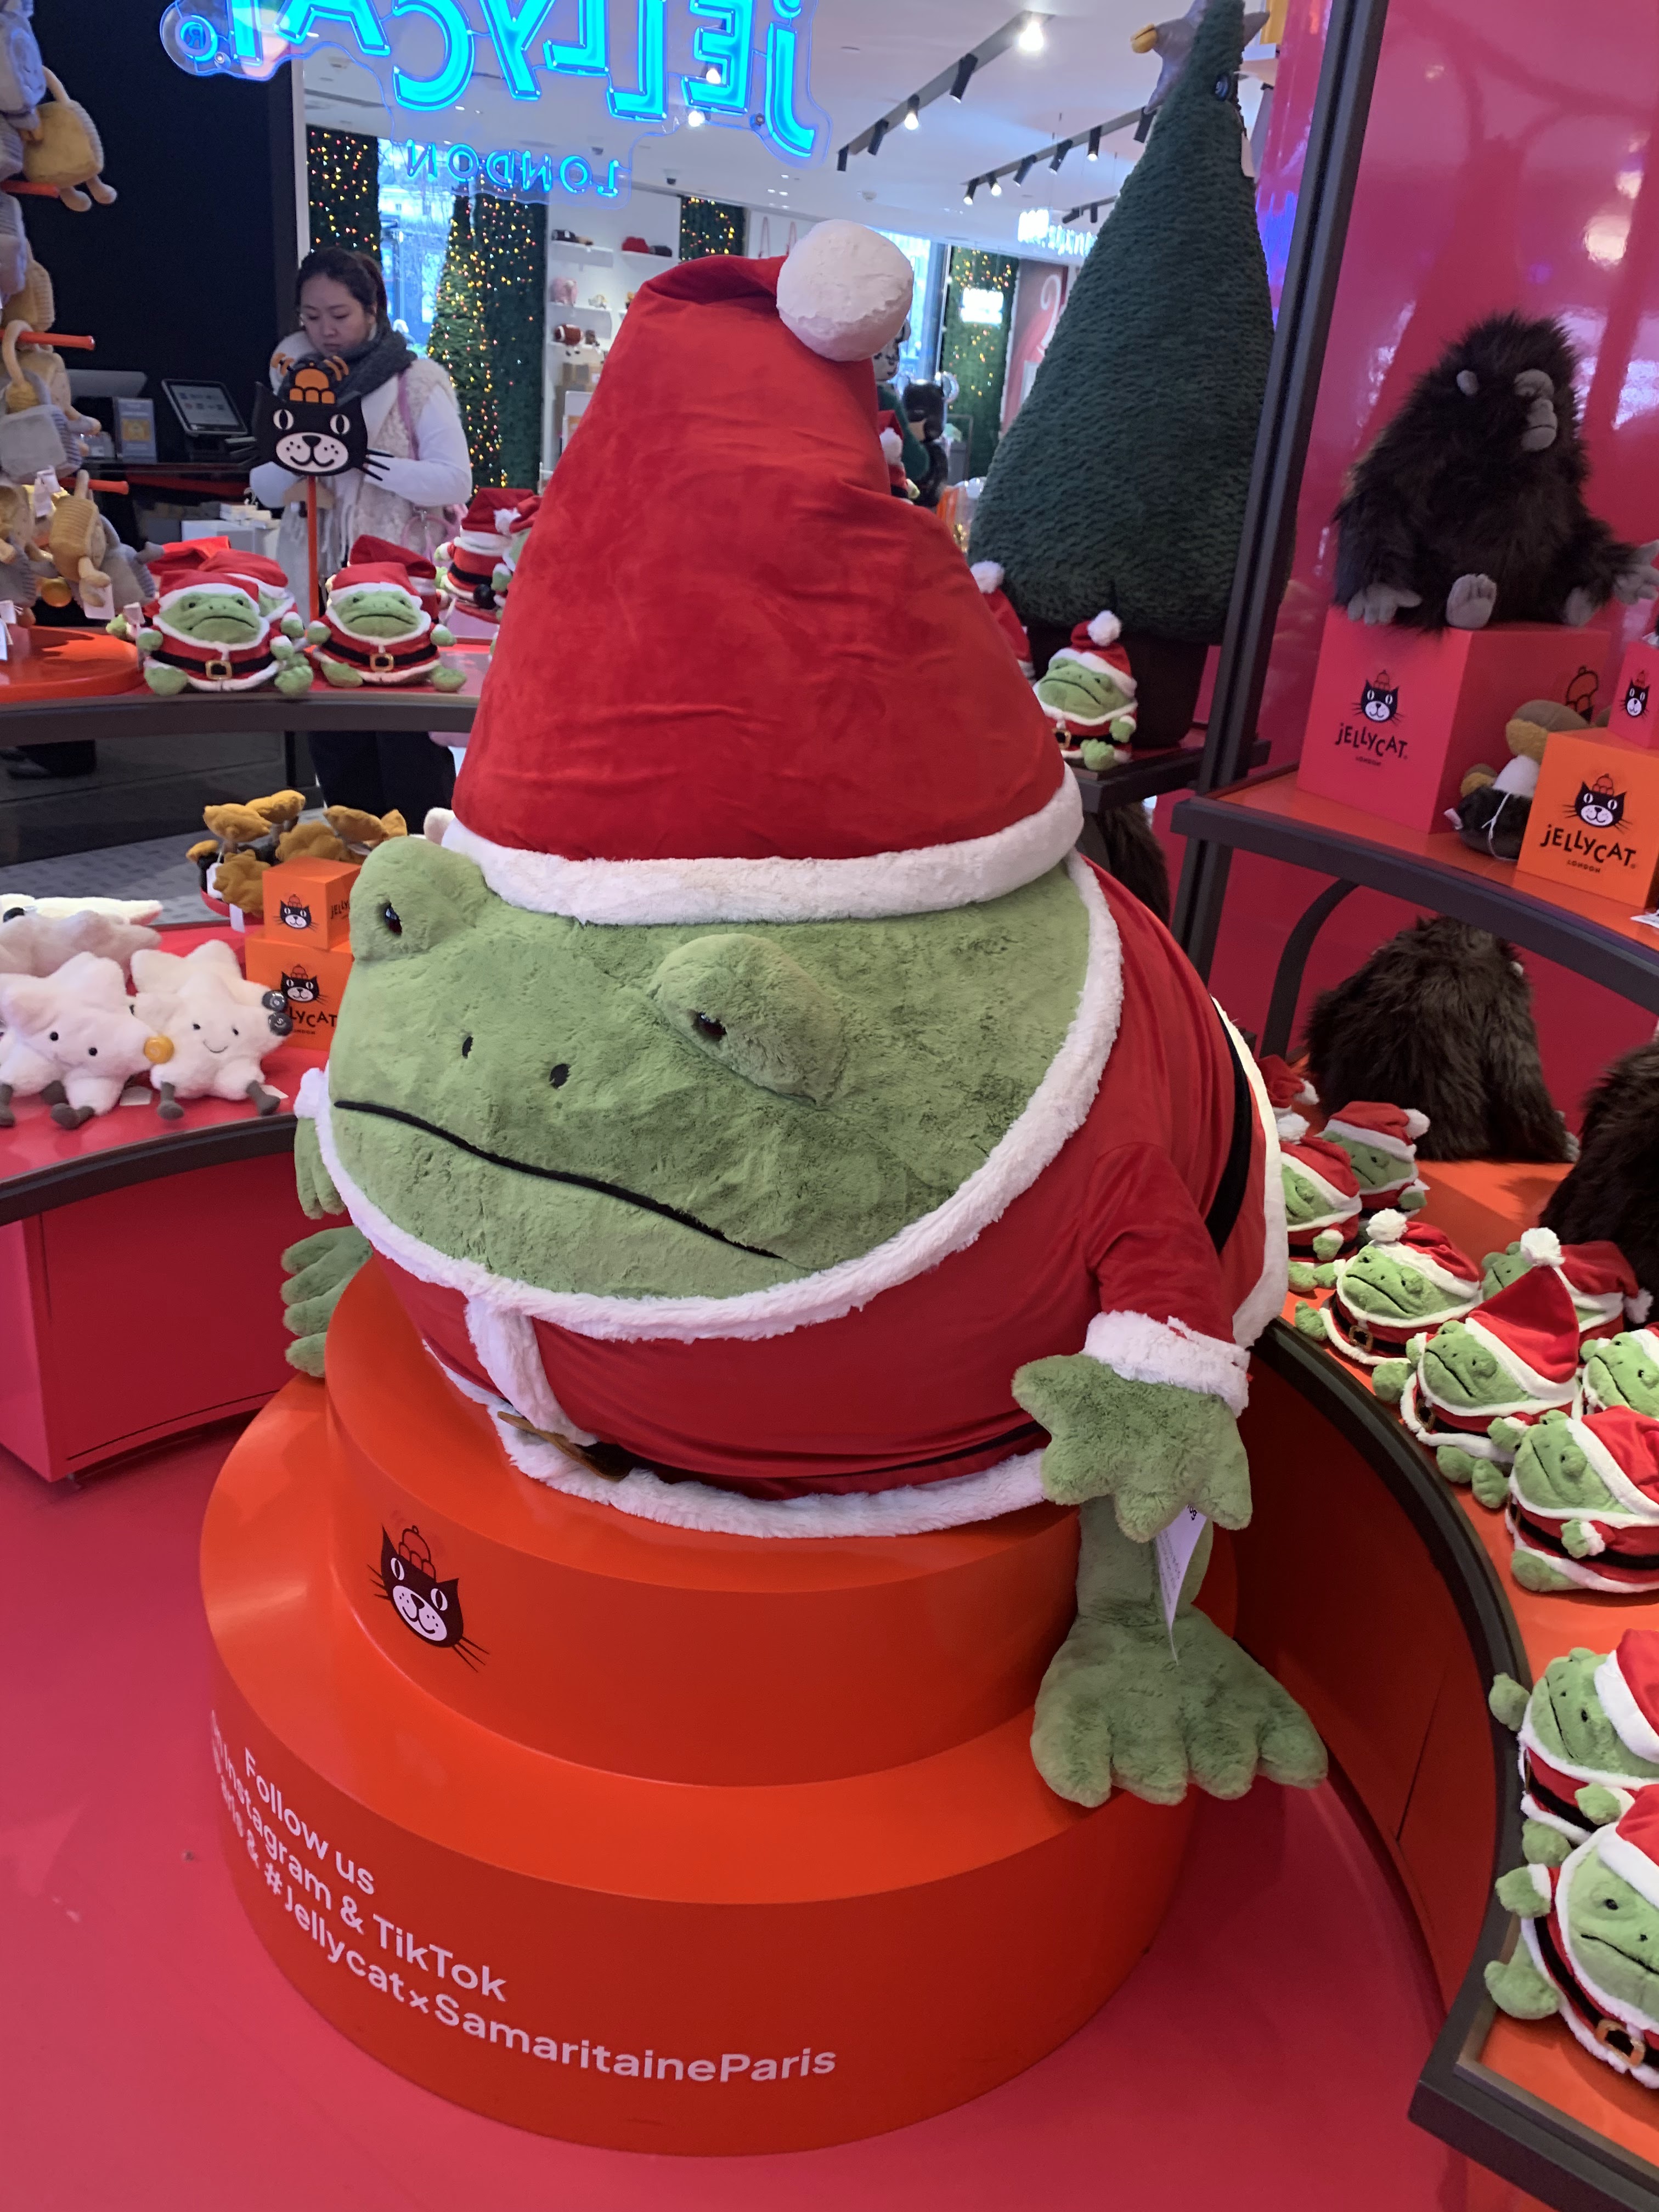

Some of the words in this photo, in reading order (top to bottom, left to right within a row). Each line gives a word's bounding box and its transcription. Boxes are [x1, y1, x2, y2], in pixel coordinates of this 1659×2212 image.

[224, 1743, 332, 1910] Instagram
[340, 1895, 363, 1934] &
[373, 1913, 506, 2002] TikTok
[245, 1747, 329, 1860] Follow
[336, 1851, 374, 1895] us
